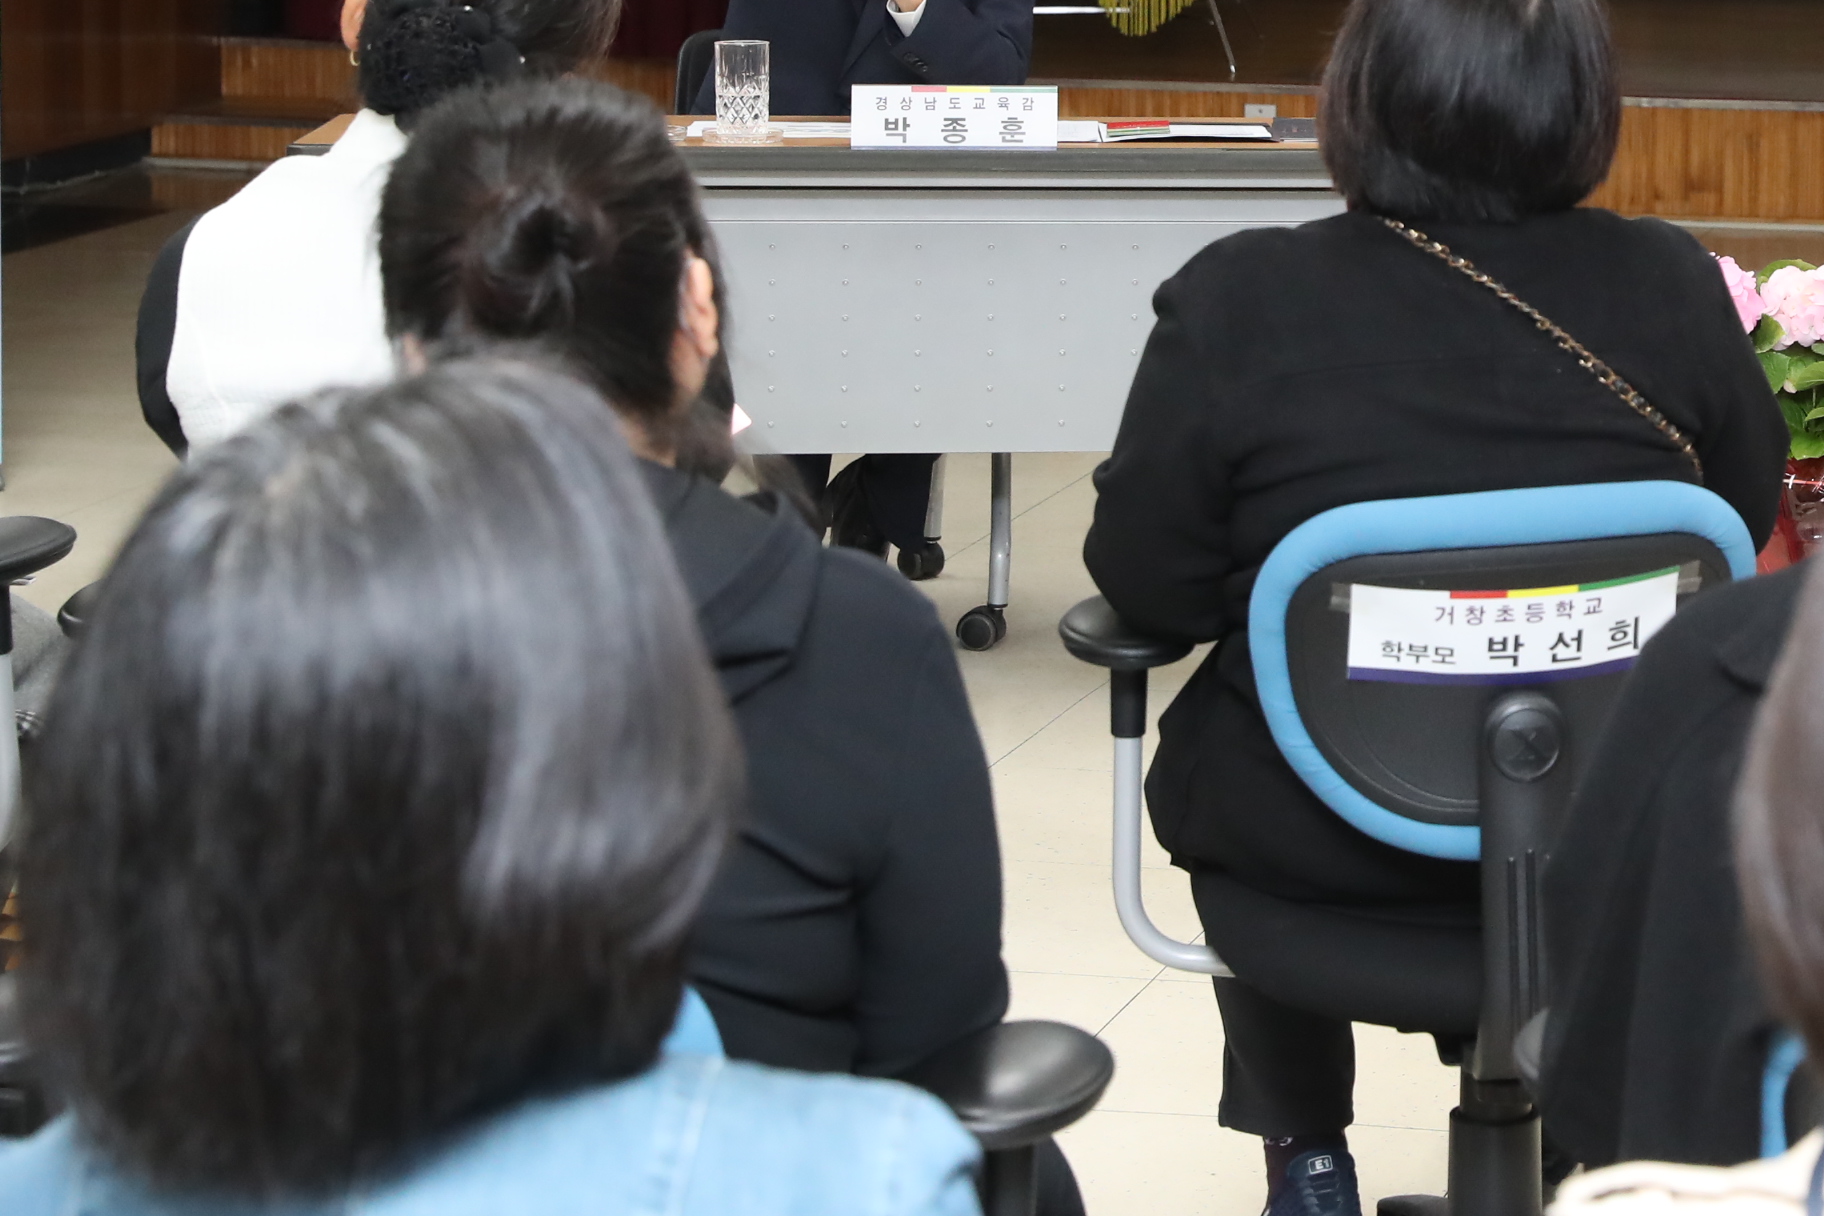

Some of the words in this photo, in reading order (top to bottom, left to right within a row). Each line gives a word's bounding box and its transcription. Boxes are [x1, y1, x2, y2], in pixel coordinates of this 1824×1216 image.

[875, 96, 1035, 112] 경상남도교육감
[1434, 596, 1604, 626] 거창초등학교
[1380, 639, 1457, 666] 학부모
[1314, 1158, 1330, 1170] E1
